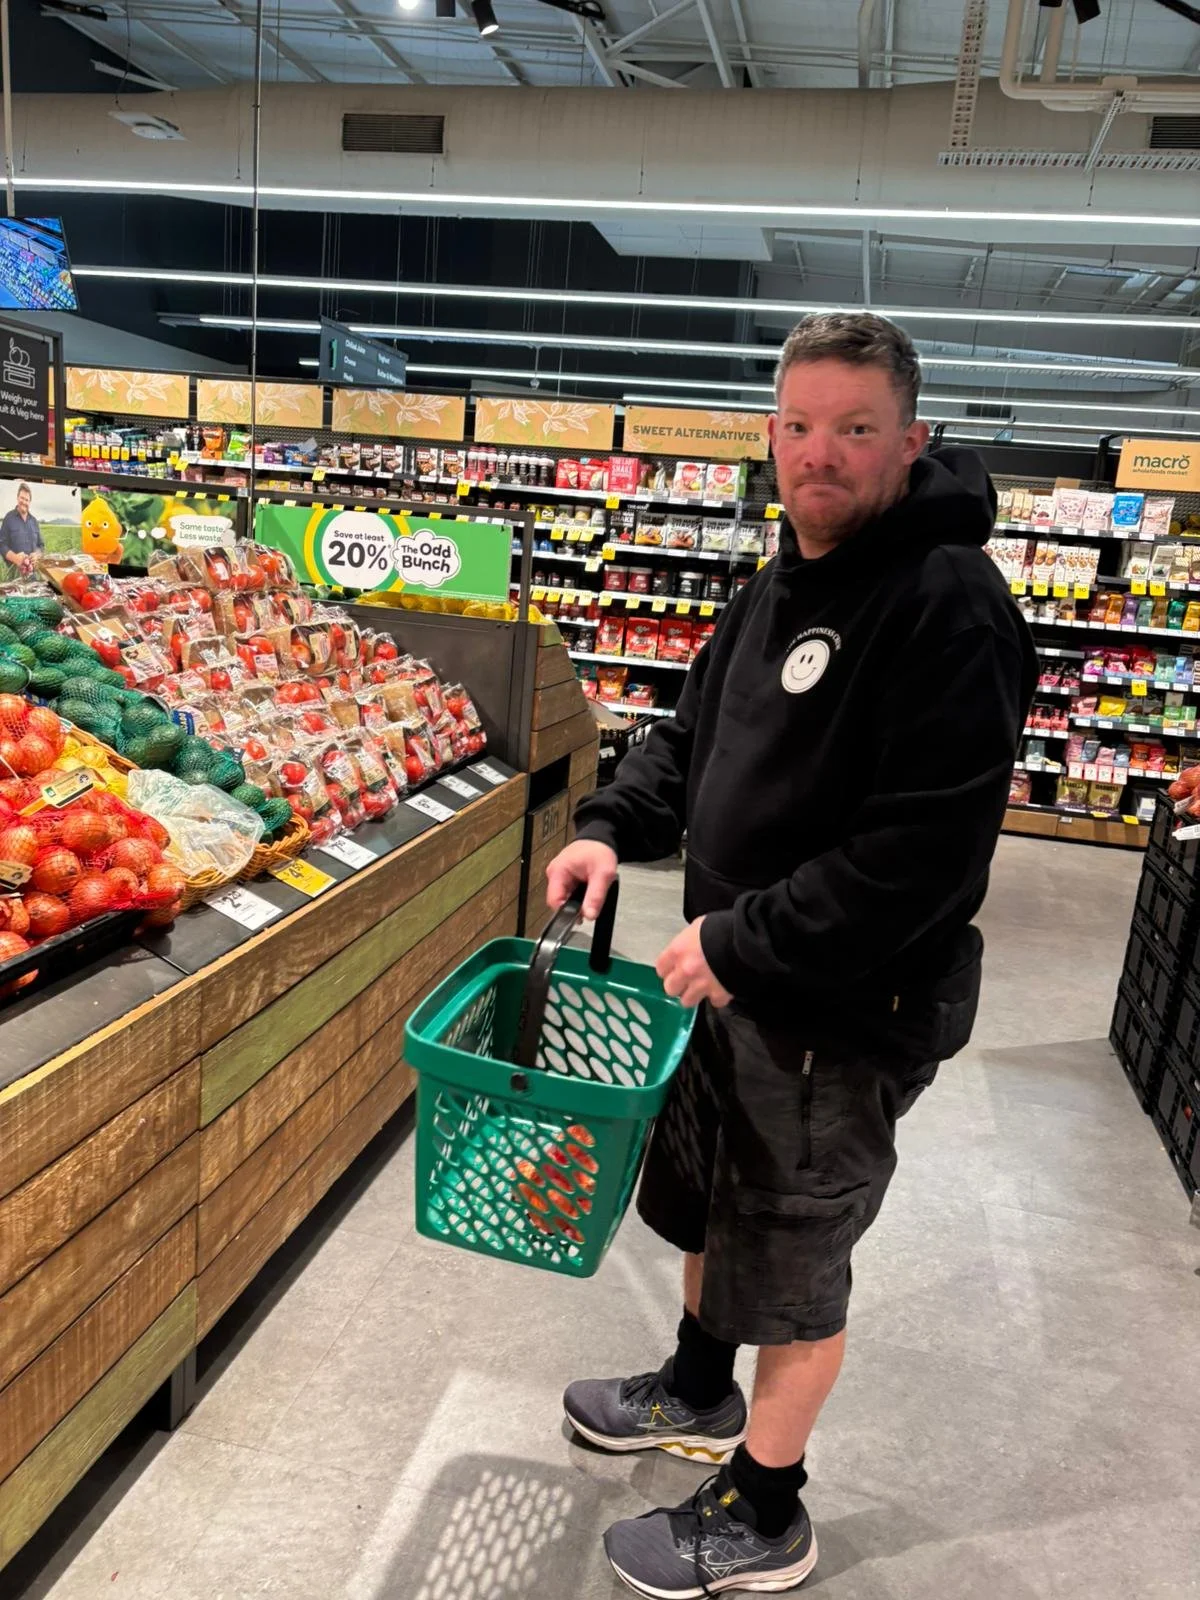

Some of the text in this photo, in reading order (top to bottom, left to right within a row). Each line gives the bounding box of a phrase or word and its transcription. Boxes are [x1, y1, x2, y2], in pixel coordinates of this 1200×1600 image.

[0, 390, 38, 407] Weigh your
[0, 404, 45, 421] uit & Veg here
[632, 425, 761, 442] SWEET ALTERNATIVES
[180, 521, 202, 532] Same
[180, 531, 197, 539] Less
[334, 530, 385, 542] Save at least
[401, 543, 451, 558] The Odd
[402, 555, 451, 573] Bunch
[797, 627, 836, 640] HAPPINESS
[542, 807, 560, 838] Bin
